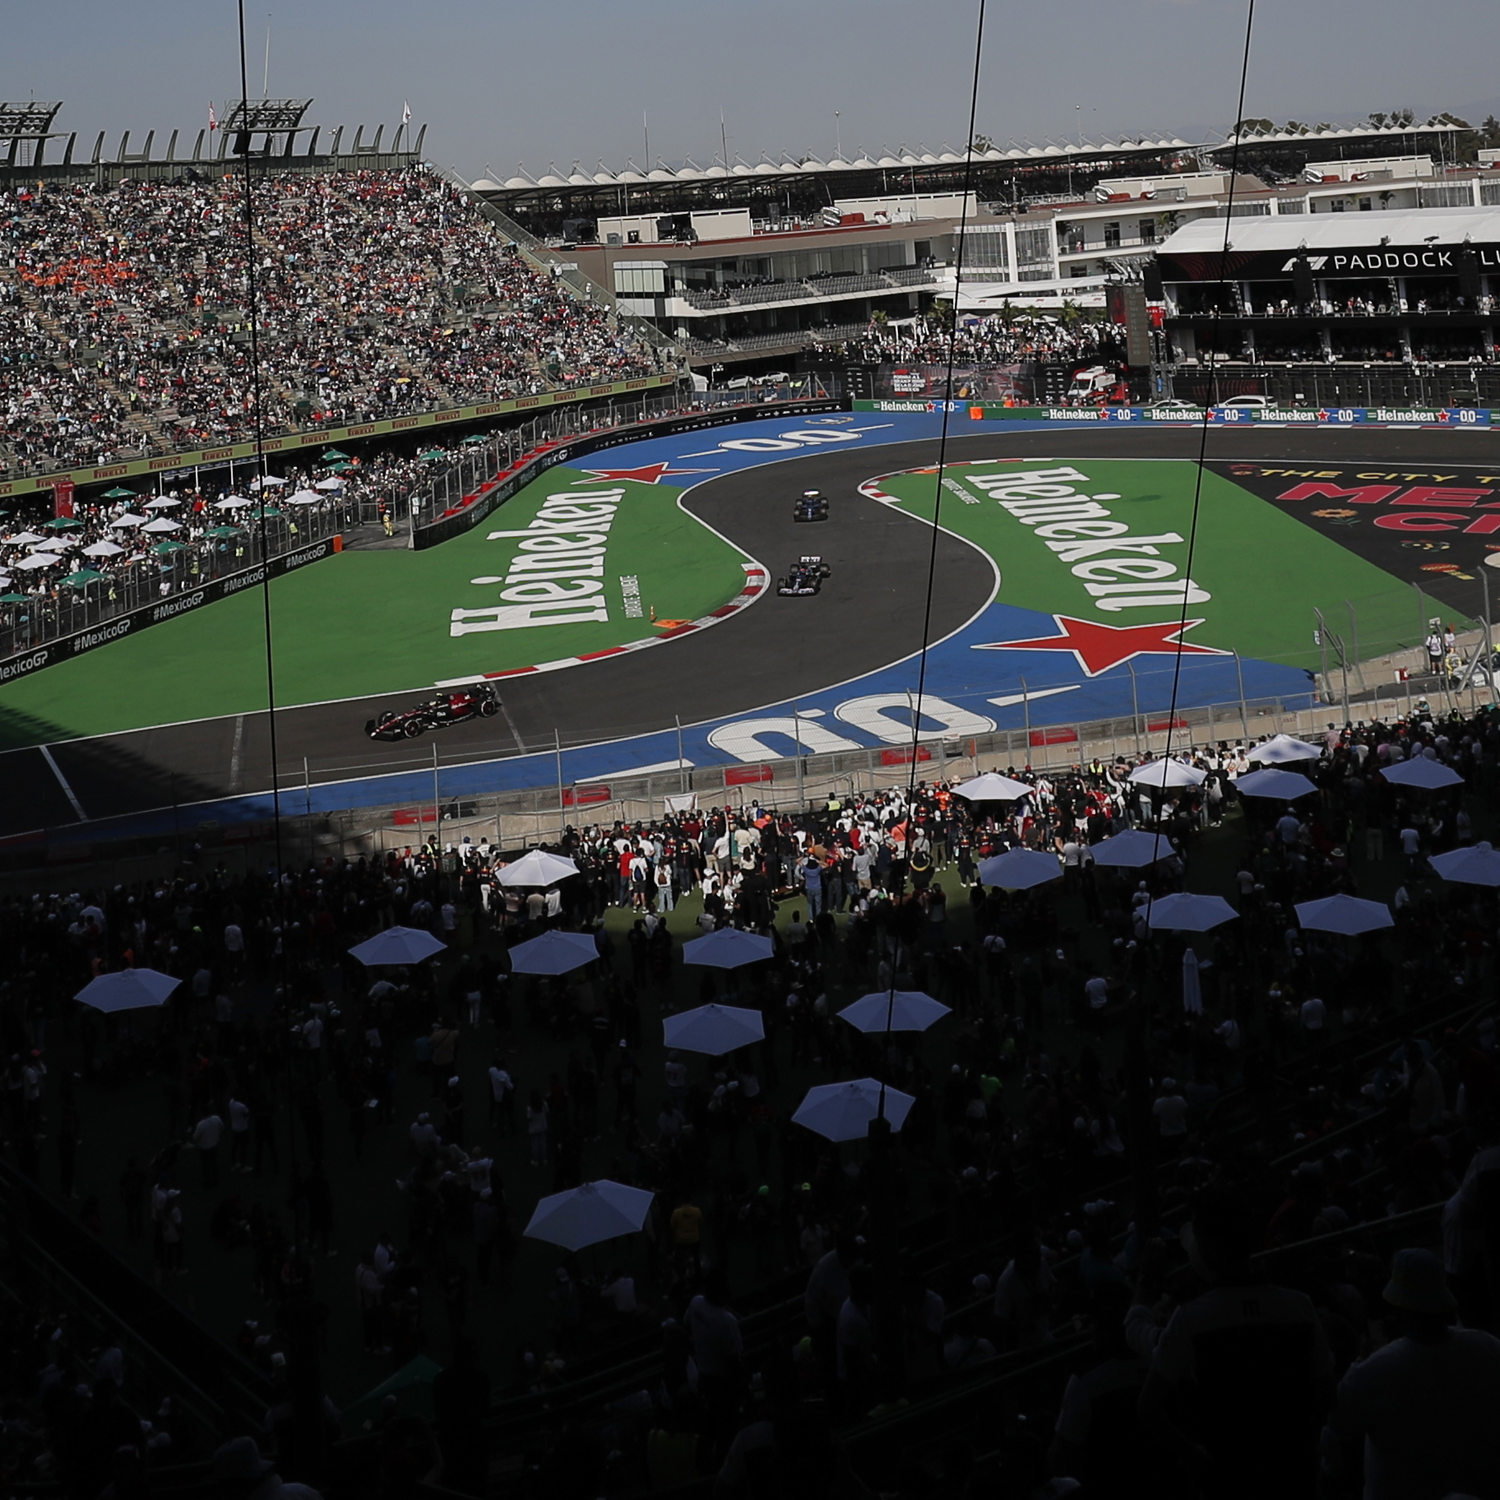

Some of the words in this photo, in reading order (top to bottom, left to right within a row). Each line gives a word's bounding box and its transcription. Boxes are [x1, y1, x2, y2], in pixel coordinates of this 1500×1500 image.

[1334, 249, 1453, 270] PADDOCK
[880, 401, 925, 412] Heineken
[1050, 409, 1098, 420] Heineken
[1151, 409, 1203, 421] Heineken
[1260, 409, 1316, 422] Heineken
[1376, 409, 1437, 422] Heineken
[393, 416, 418, 429] PIRELLI
[348, 424, 374, 437] PIRELLI
[301, 431, 329, 445] PIRELLI
[202, 446, 232, 461] PIRELLI
[149, 454, 181, 470] PIRELLI
[94, 465, 127, 480] PIRELLI
[1259, 468, 1344, 479] THE
[1355, 472, 1459, 482] CITY
[964, 465, 1212, 611] Heineken
[285, 544, 326, 568] #MexicoGP
[450, 487, 626, 637] Heineken
[153, 592, 204, 620] #MexicoGP
[73, 620, 131, 652] #MexicoGP
